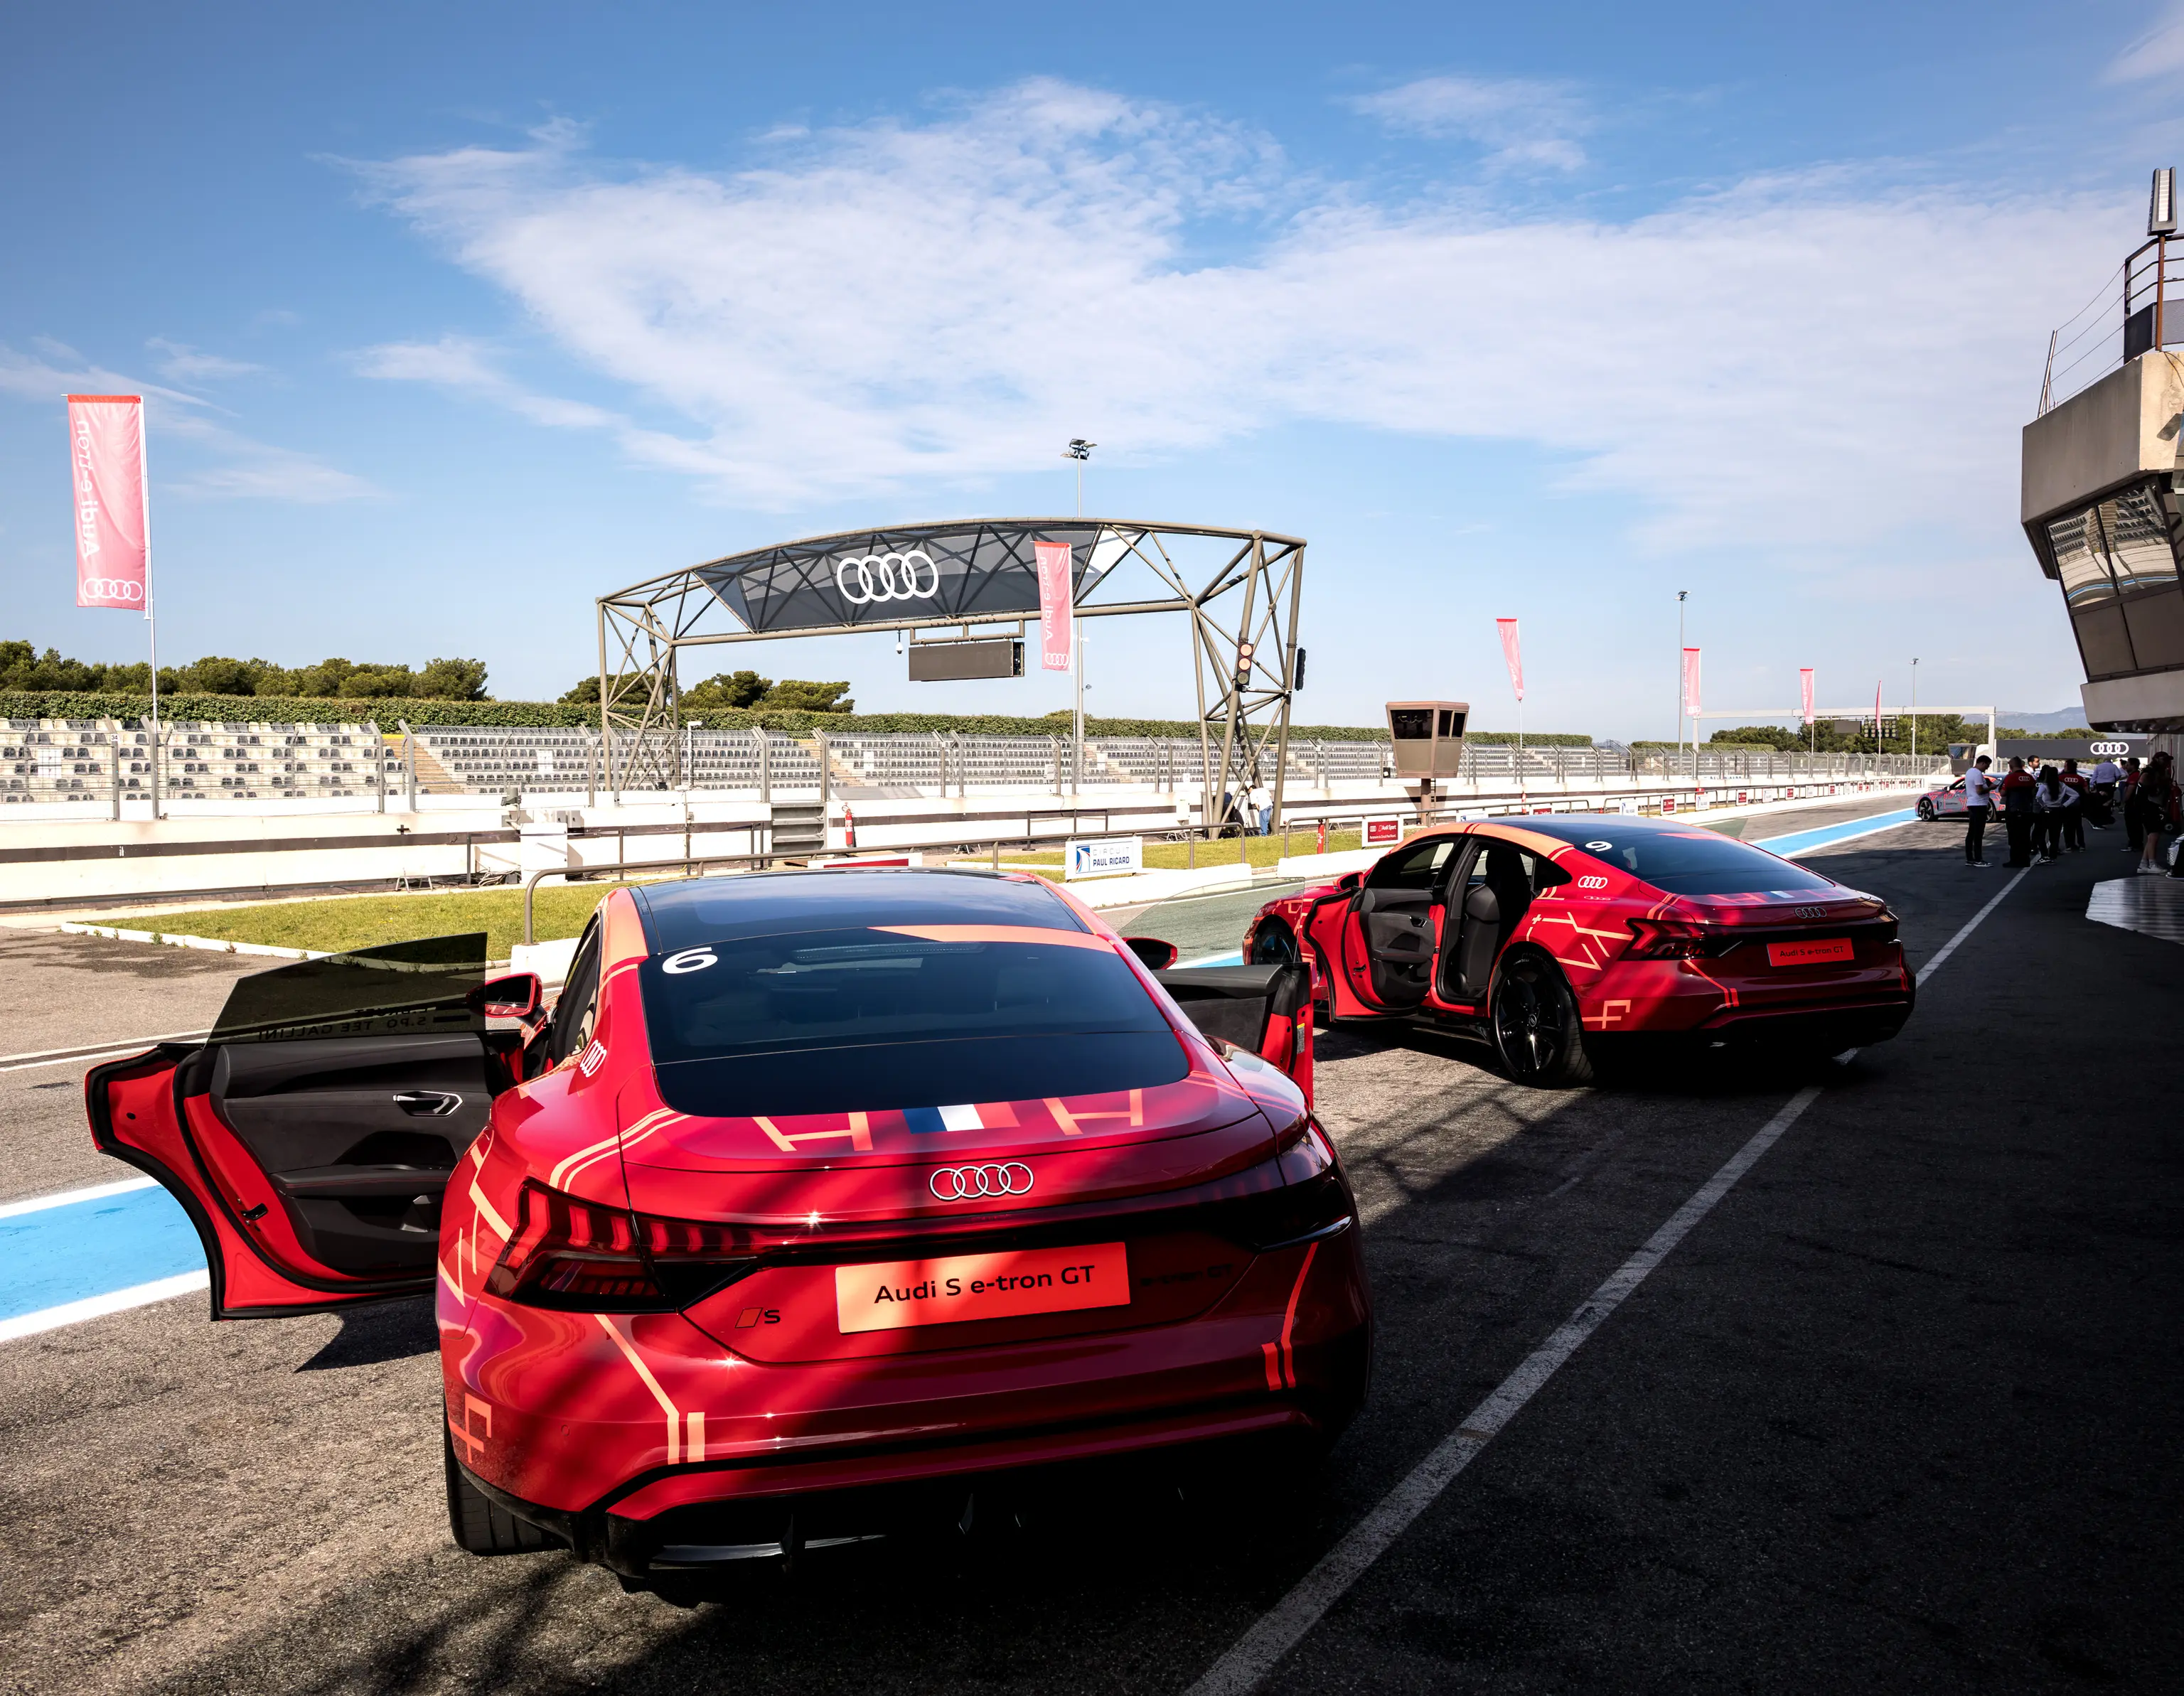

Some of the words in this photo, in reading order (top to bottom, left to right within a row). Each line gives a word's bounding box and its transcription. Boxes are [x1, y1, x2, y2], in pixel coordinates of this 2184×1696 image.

[1093, 847, 1130, 856] CIRCUIT
[1109, 857, 1130, 865] RICARD
[662, 947, 718, 975] 6
[874, 1280, 936, 1304] Audi
[946, 1278, 961, 1297] S
[970, 1272, 1052, 1294] e-tron
[1061, 1265, 1095, 1284] GT
[764, 1309, 781, 1324] S
